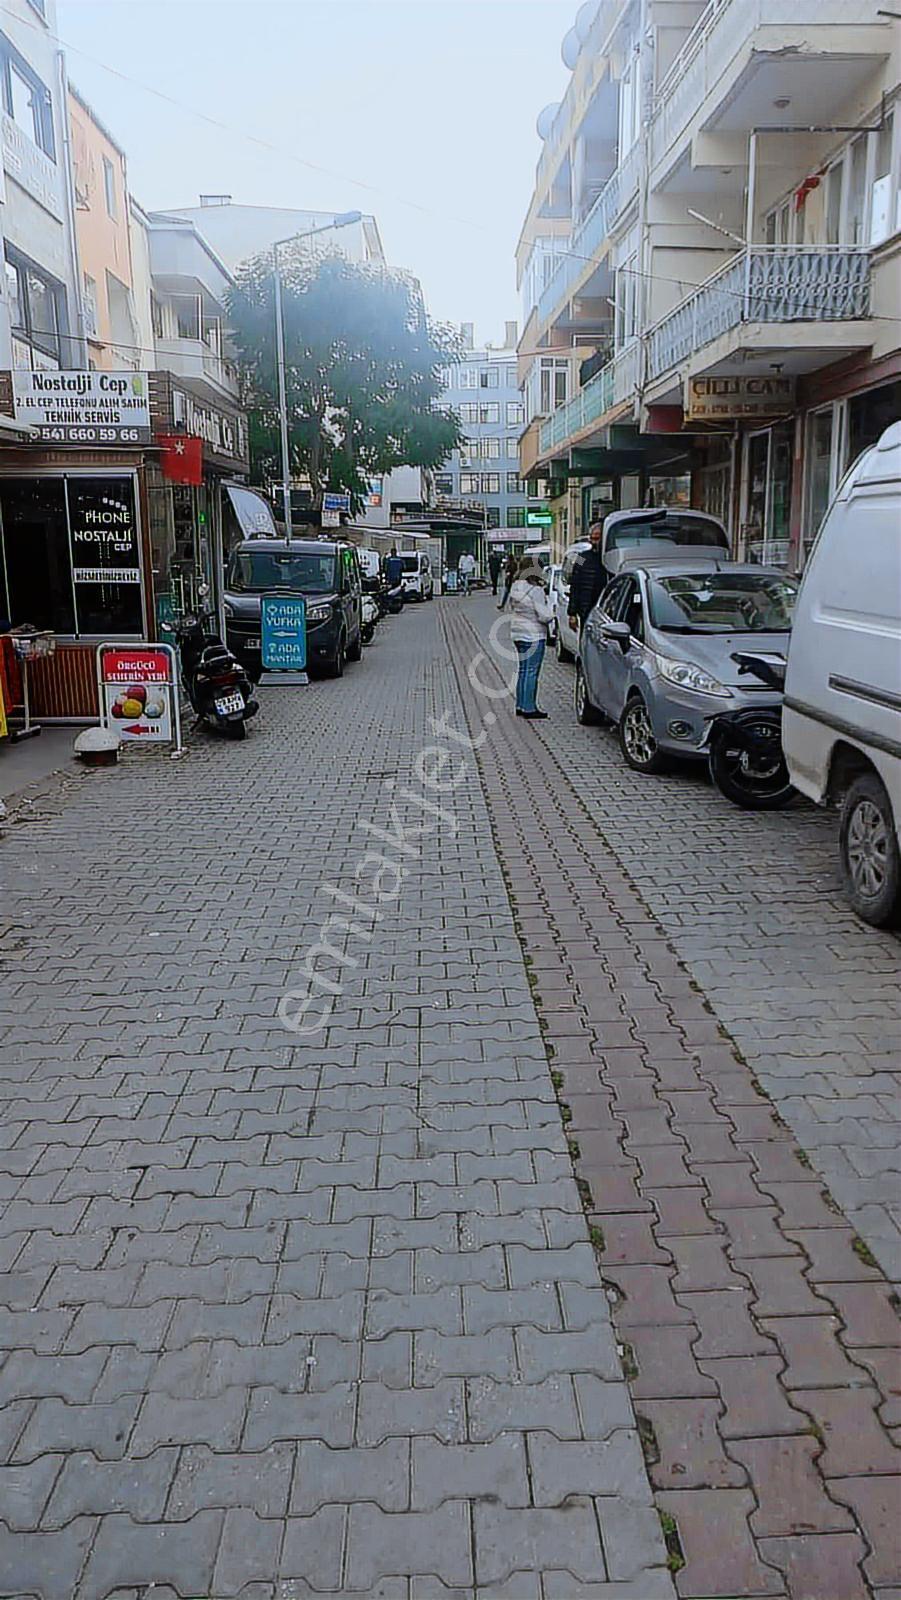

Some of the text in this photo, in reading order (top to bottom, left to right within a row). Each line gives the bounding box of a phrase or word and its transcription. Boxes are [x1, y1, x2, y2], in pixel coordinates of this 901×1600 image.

[32, 374, 128, 396] Nostalji Cep
[26, 398, 36, 407] EL
[37, 398, 53, 407] CEP
[55, 398, 97, 408] TELEFONU
[99, 398, 120, 408] ALIM
[85, 409, 121, 423] SERVİS
[69, 428, 96, 440] 660
[99, 428, 117, 440] 59
[120, 428, 139, 440] 66
[85, 512, 130, 523] PHONE
[114, 543, 132, 551] CEP
[279, 606, 301, 615] ADA
[266, 617, 301, 627] YUFKA
